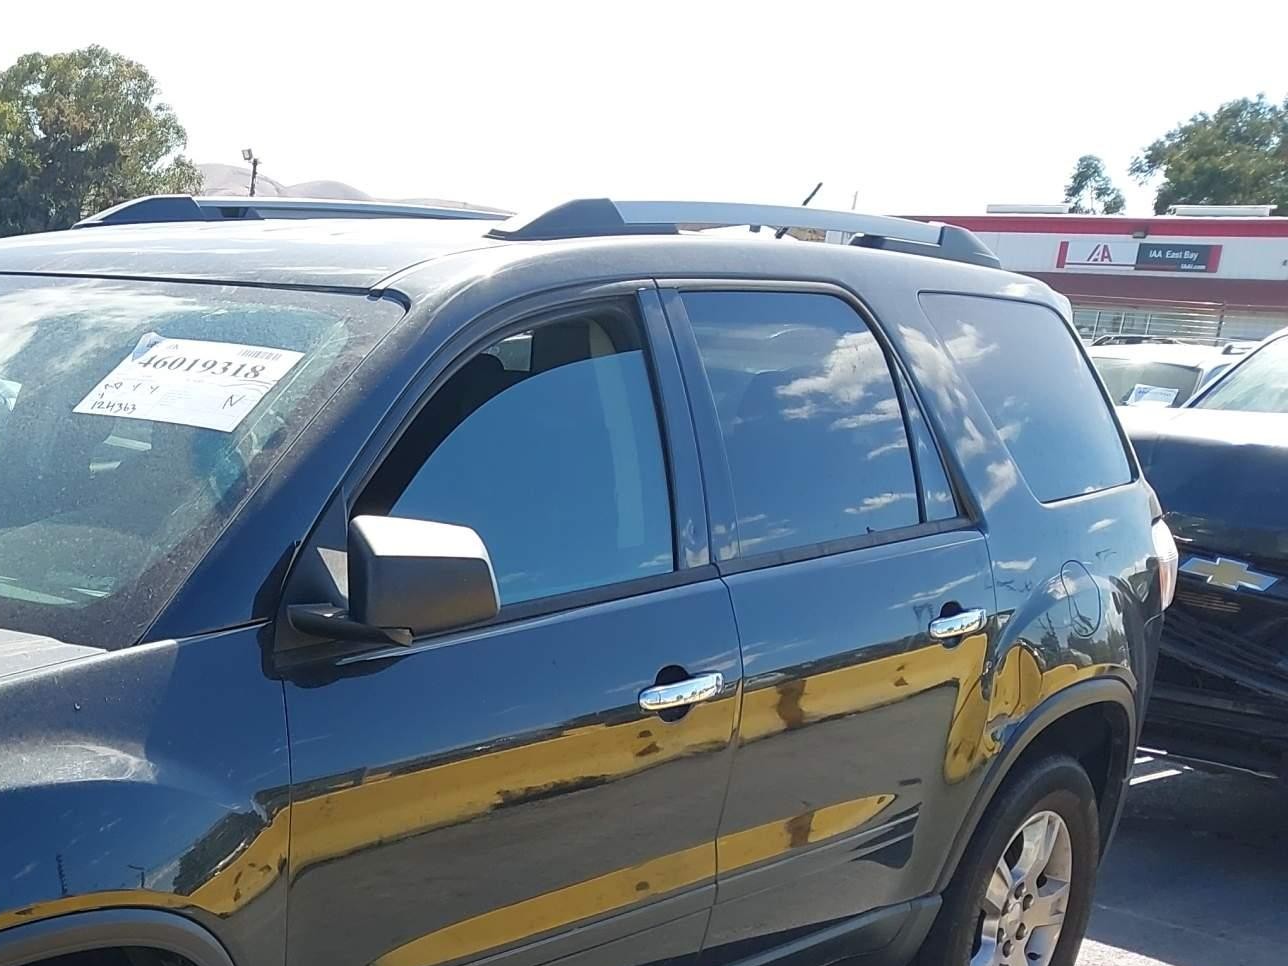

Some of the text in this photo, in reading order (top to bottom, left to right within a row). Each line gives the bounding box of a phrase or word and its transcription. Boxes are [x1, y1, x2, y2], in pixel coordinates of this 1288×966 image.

[1149, 249, 1199, 261] IAA East Bay
[138, 354, 266, 379] 46019318
